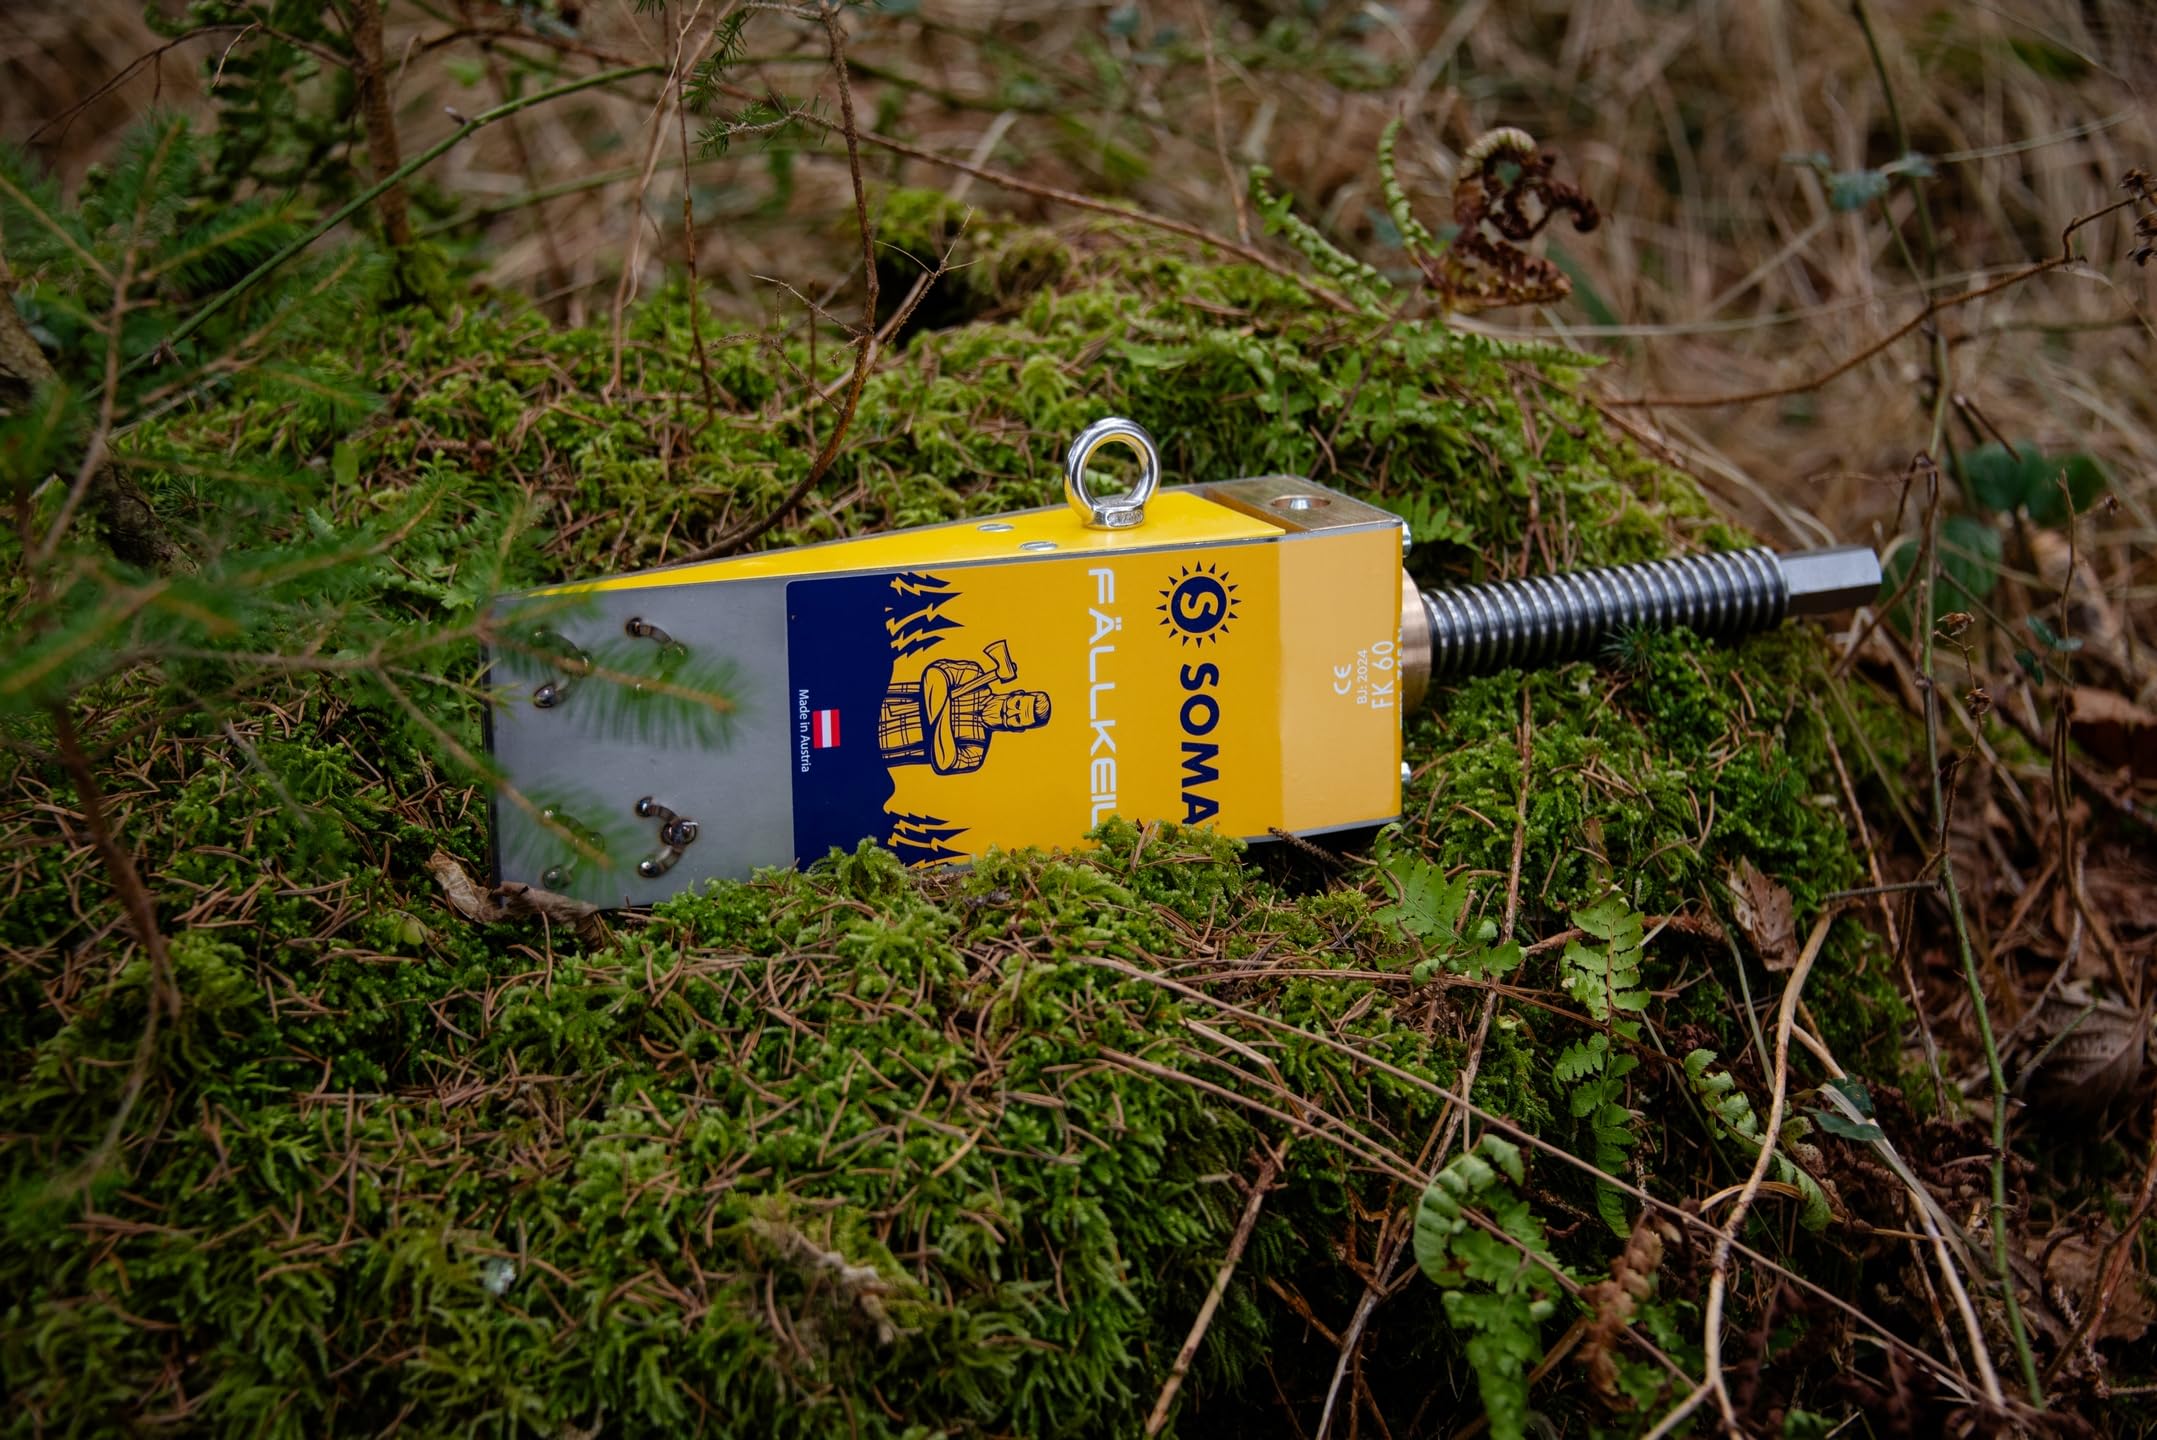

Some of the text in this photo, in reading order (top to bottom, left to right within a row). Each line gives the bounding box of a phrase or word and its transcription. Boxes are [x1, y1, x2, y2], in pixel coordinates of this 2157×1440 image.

[1088, 568, 1122, 829] FÄLLKEIL
[1357, 648, 1368, 683] 2024
[1371, 640, 1395, 709] FK 60
[799, 689, 811, 773] Made in Austria
[1180, 662, 1219, 825] SOMA
